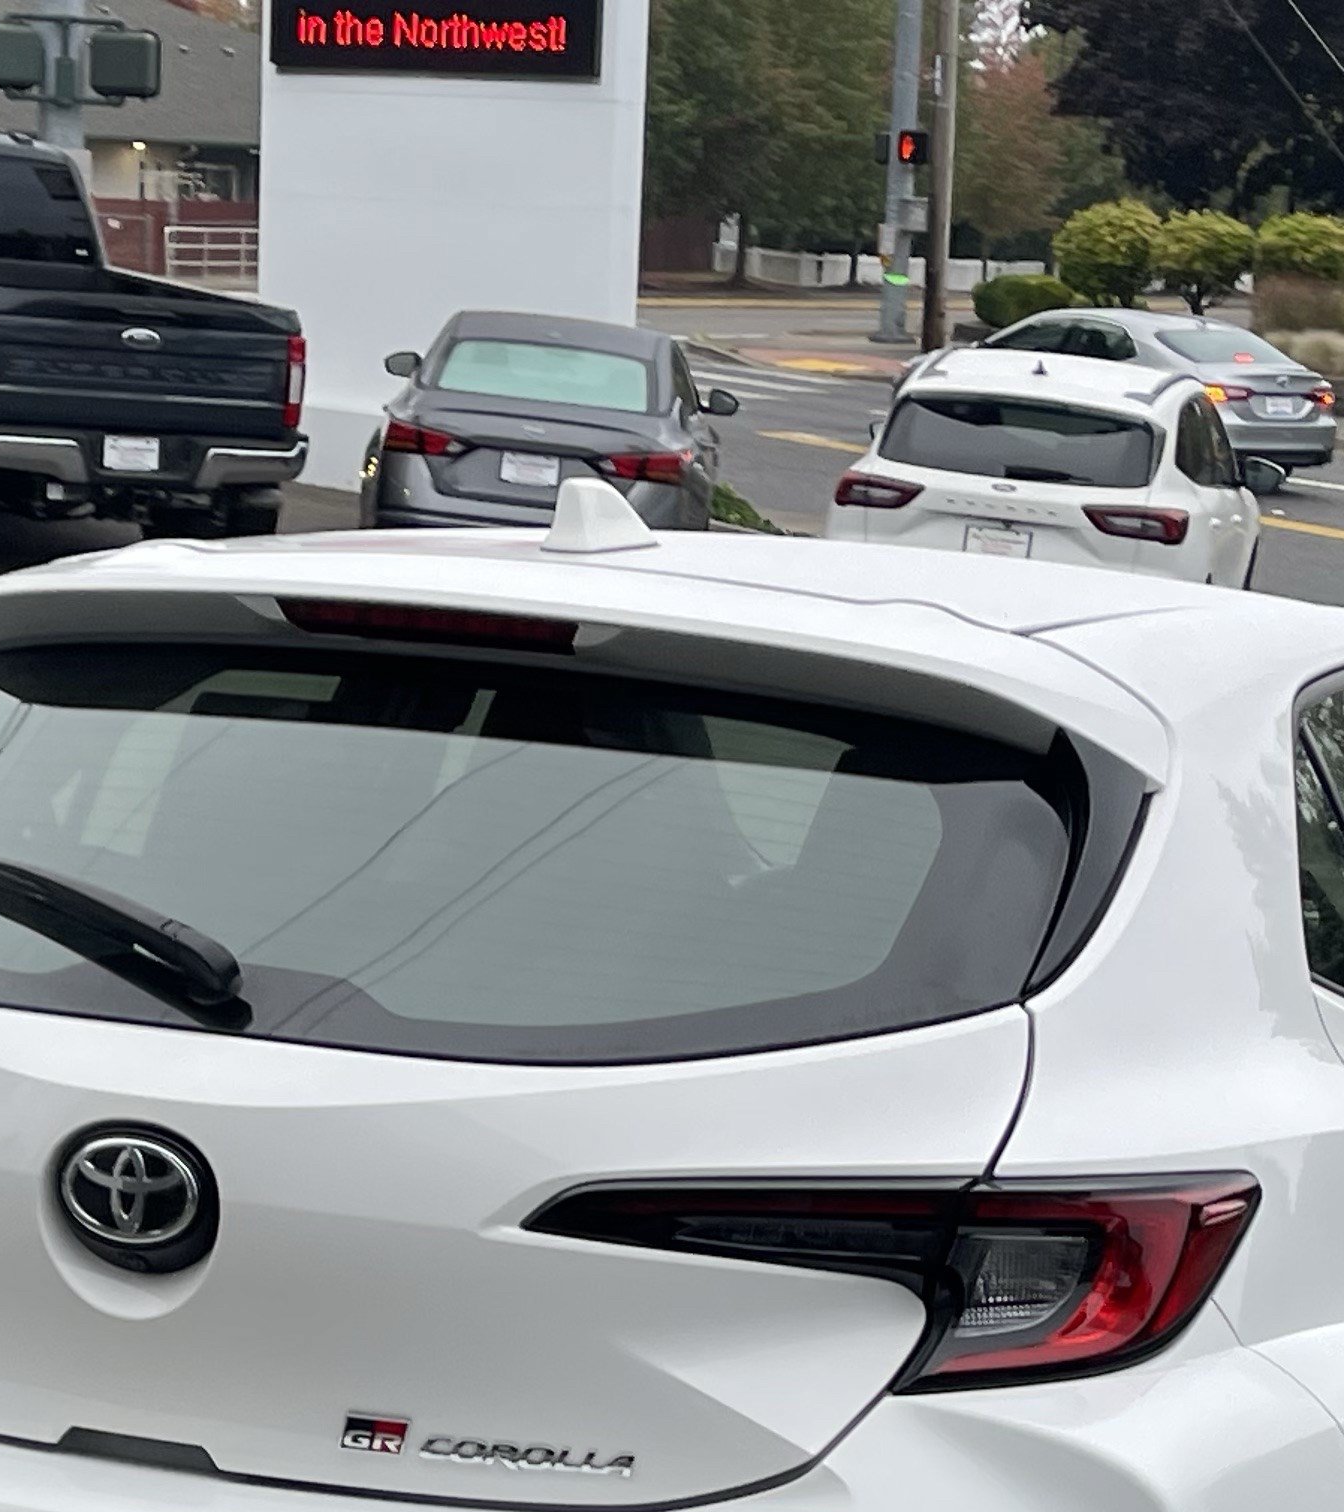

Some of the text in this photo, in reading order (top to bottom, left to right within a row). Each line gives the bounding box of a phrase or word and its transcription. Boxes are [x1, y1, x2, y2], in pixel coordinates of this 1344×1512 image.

[297, 9, 567, 52] in the Northwest!
[342, 1428, 636, 1478] GR COROLLA
